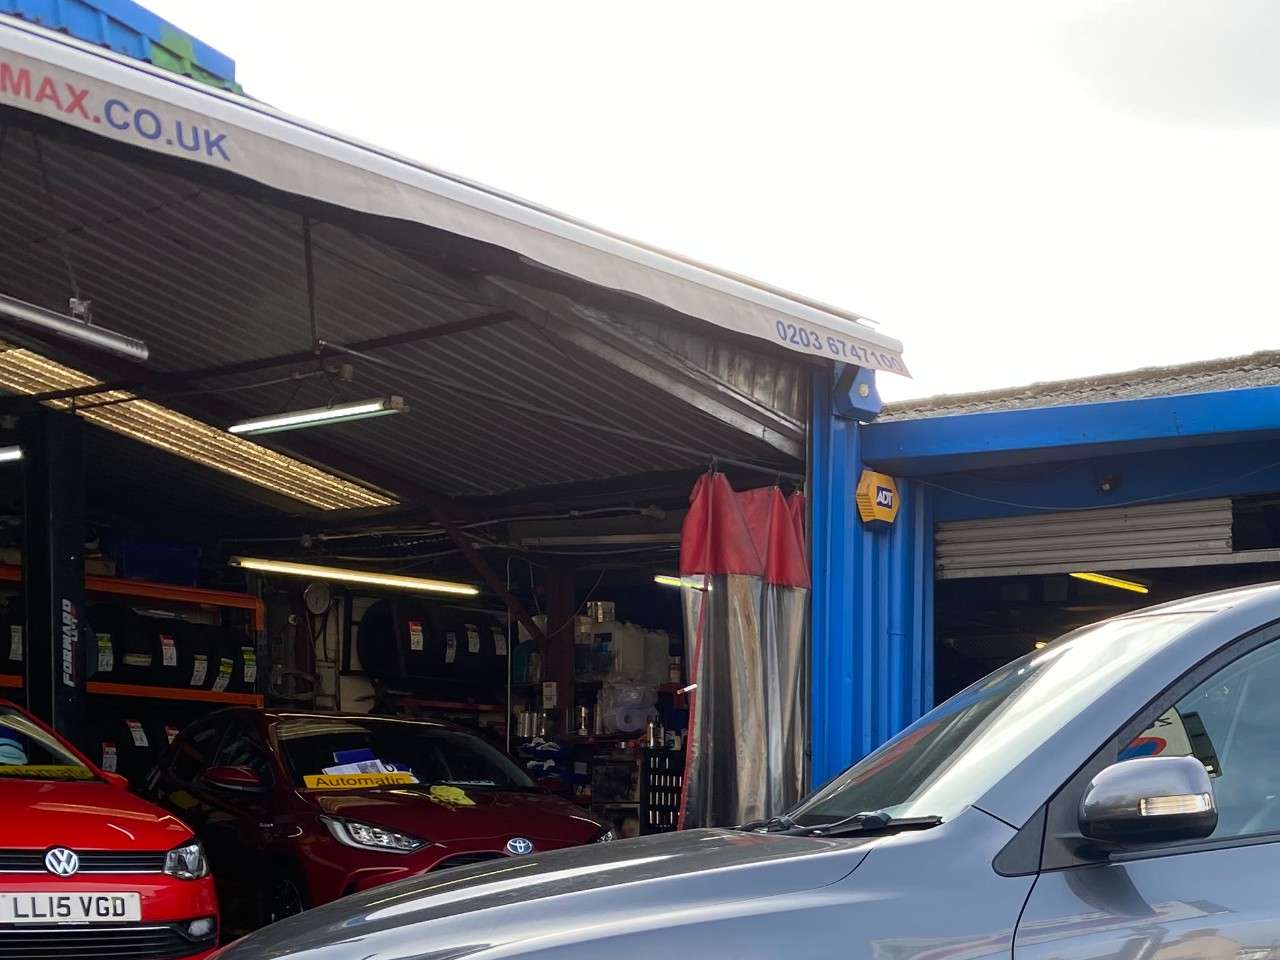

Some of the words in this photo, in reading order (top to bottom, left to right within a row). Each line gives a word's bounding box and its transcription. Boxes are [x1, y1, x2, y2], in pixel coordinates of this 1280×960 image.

[776, 320, 823, 350] 0203
[877, 490, 893, 506] ADT
[13, 897, 72, 918] LL15
[79, 896, 125, 917] VGD
